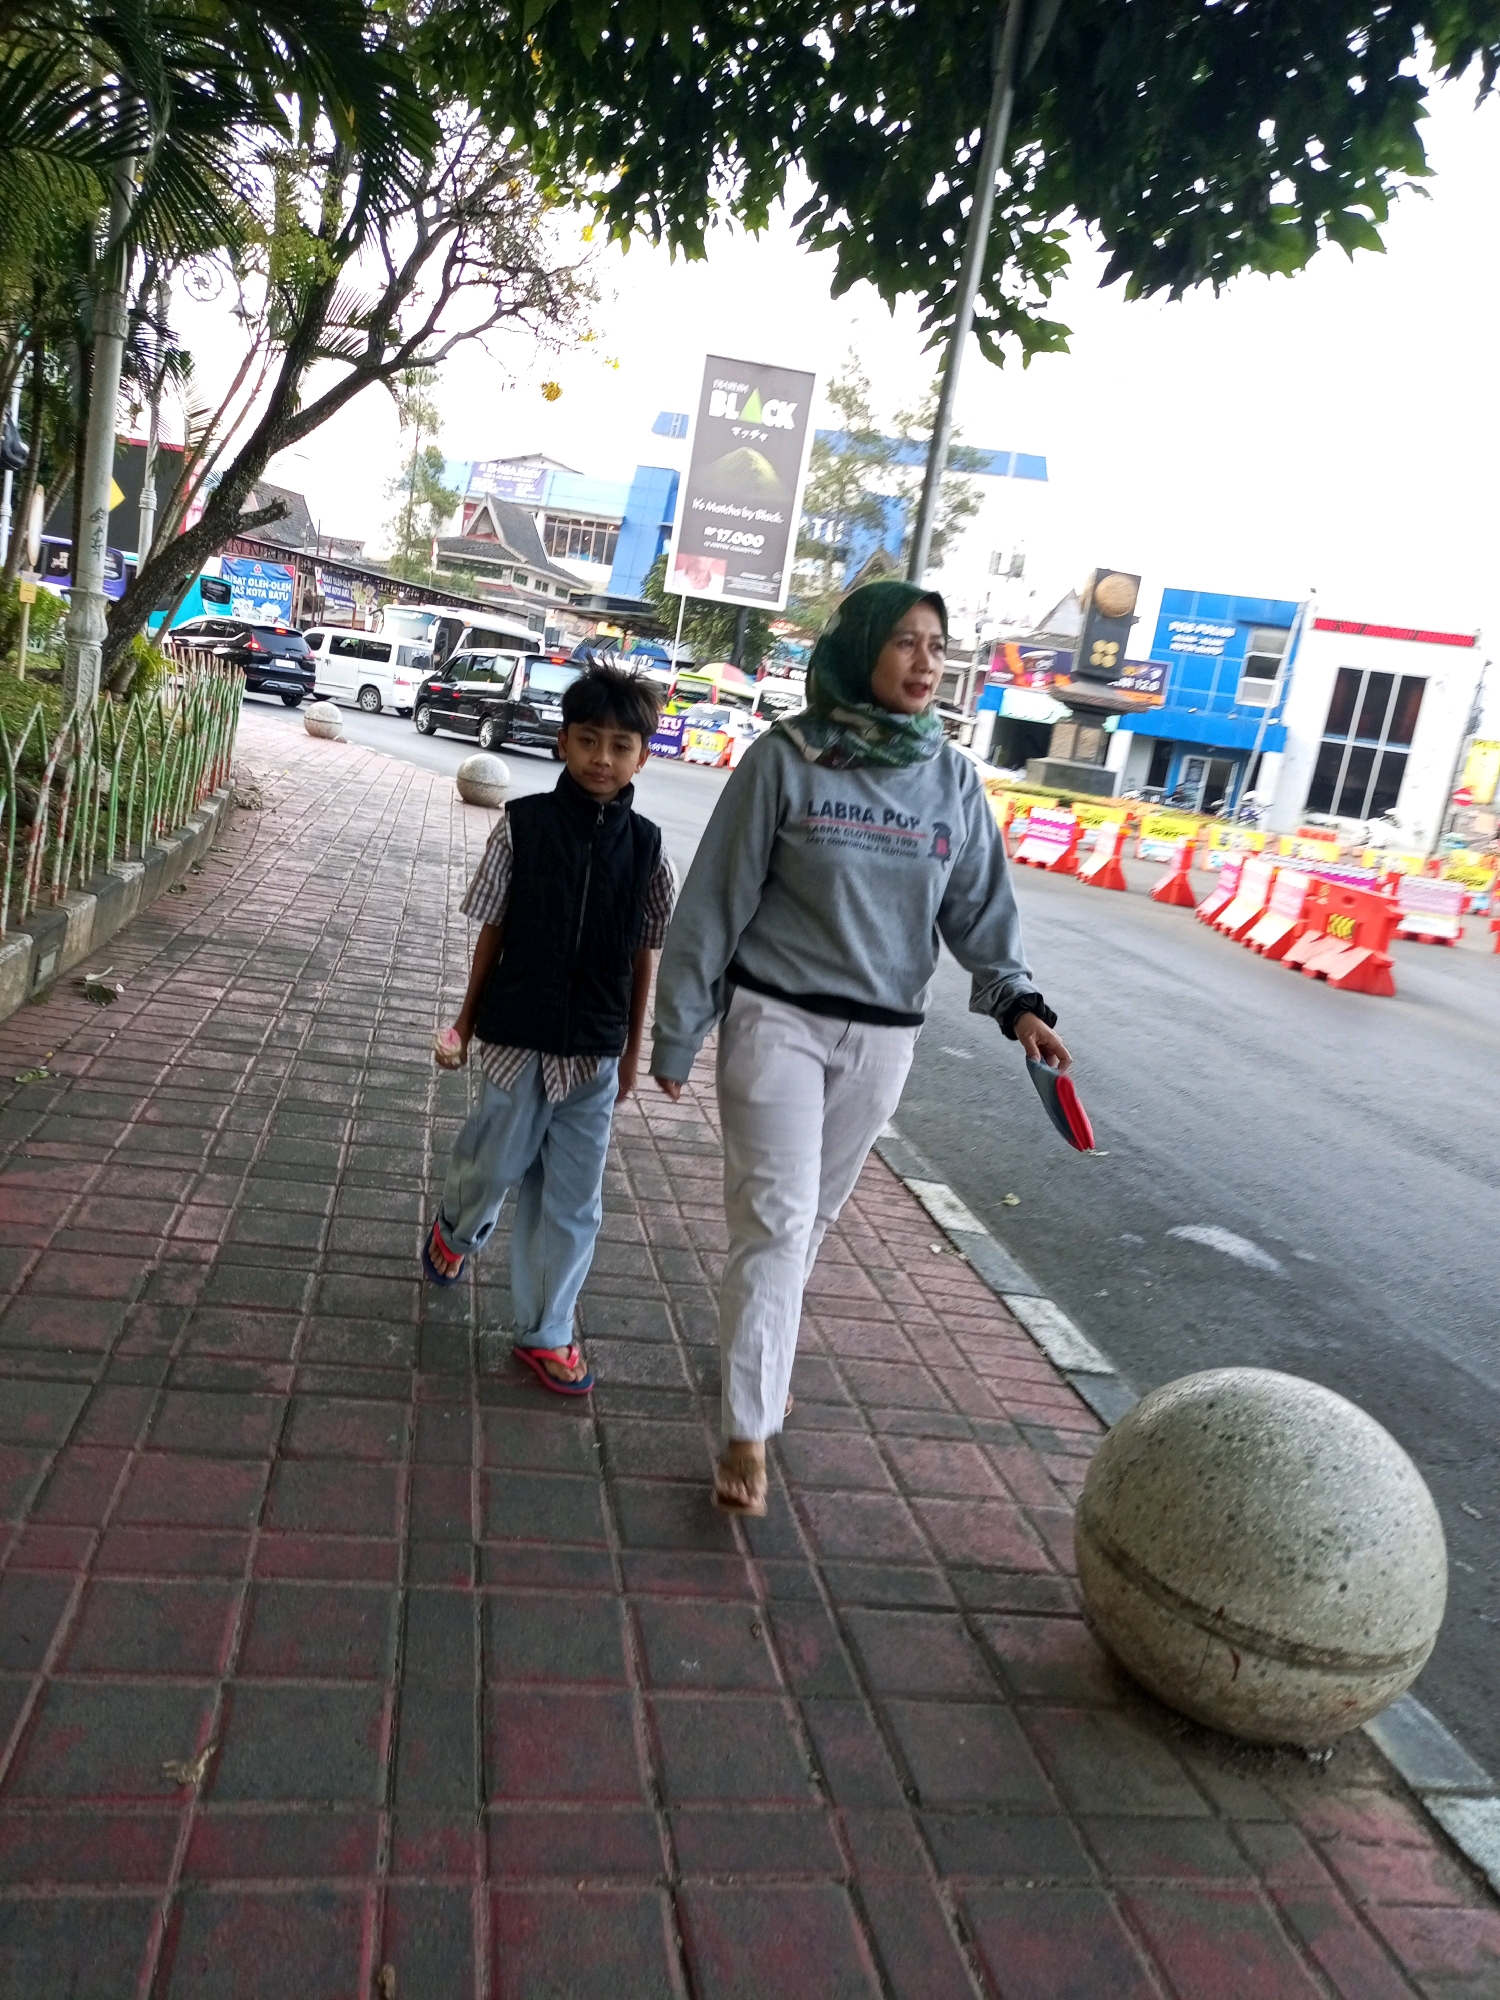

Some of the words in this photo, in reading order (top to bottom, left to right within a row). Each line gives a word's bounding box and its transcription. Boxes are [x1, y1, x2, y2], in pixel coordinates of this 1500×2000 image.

[708, 386, 798, 430] BLACK
[716, 528, 766, 548] 17.000
[222, 573, 247, 586] PUSAT
[247, 577, 292, 592] OLEH-OLEH
[246, 587, 267, 599] KOTA
[268, 590, 289, 601] BATU
[807, 799, 876, 823] LABRA
[842, 827, 893, 846] CLOTHING
